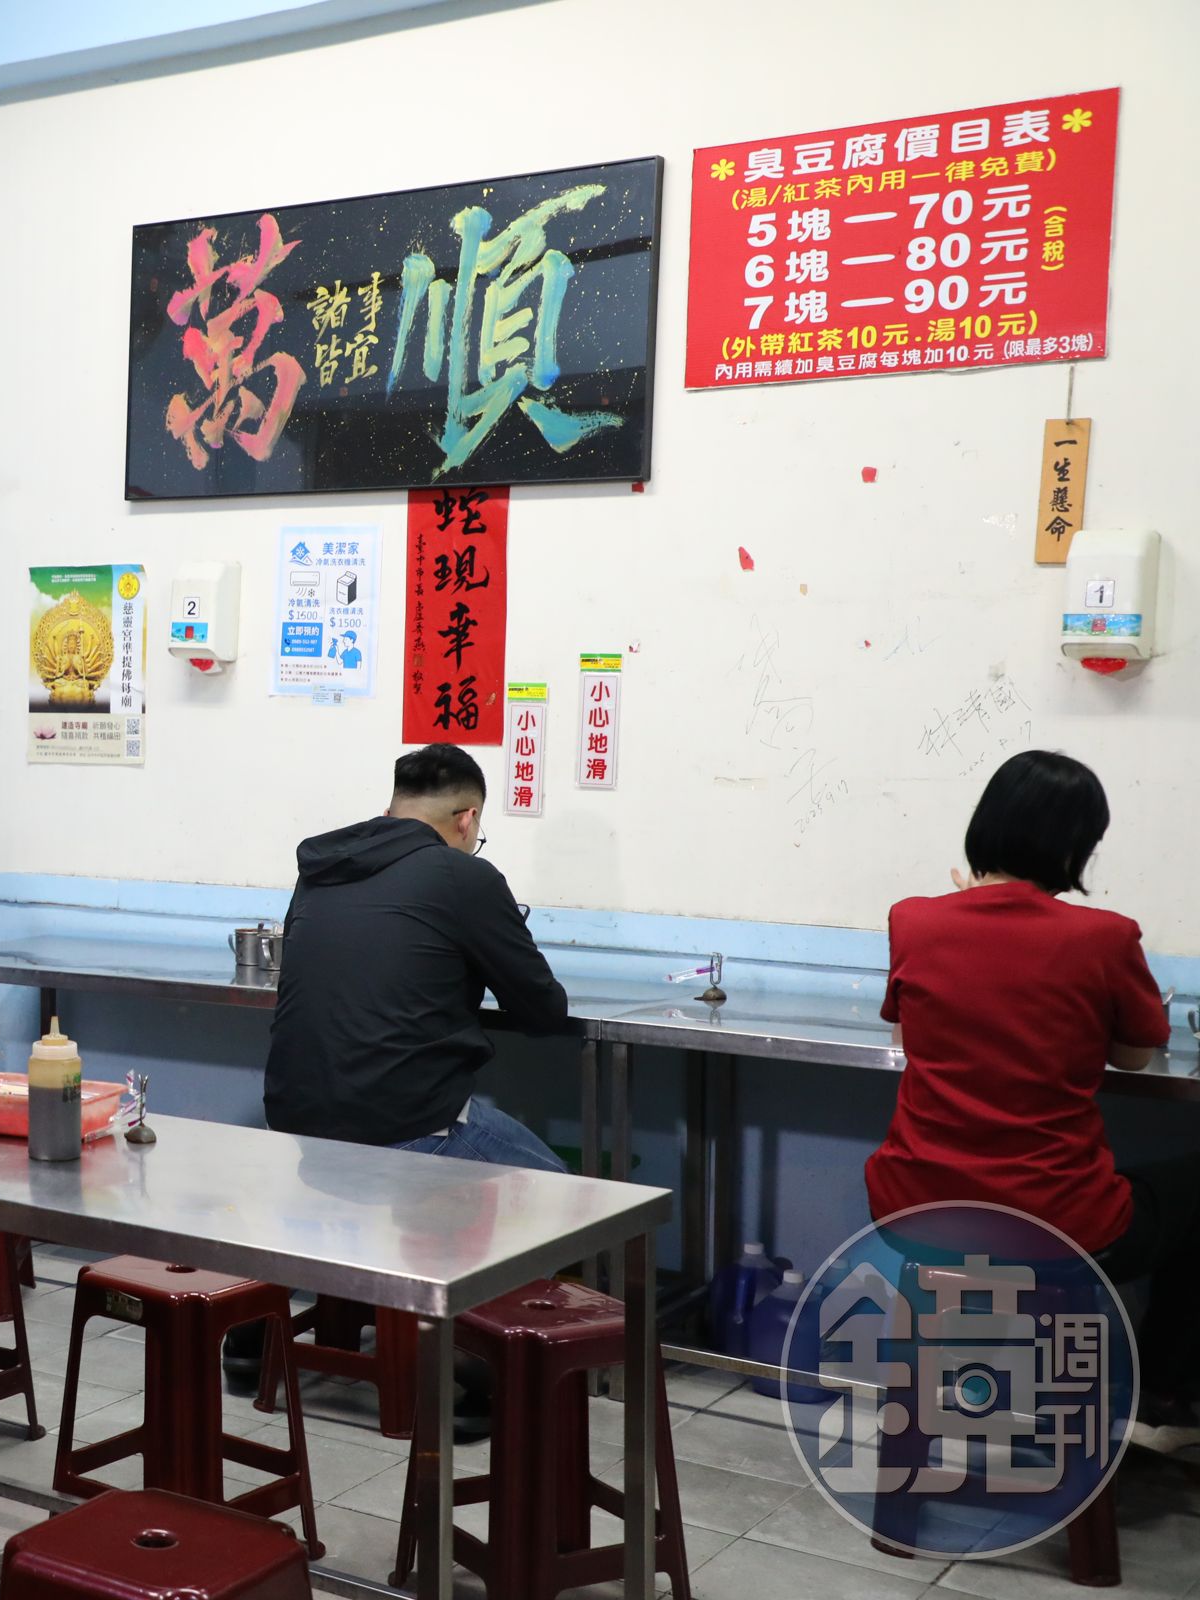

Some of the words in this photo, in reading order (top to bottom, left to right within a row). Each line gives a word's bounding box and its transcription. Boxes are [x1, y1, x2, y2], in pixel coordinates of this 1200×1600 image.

[743, 109, 1050, 183] 臭豆腐價目表
[386, 183, 625, 484] 順
[187, 600, 196, 616] 2
[1094, 584, 1104, 604] 1
[513, 710, 536, 807] 小心地滑
[586, 681, 611, 780] 小心地滑
